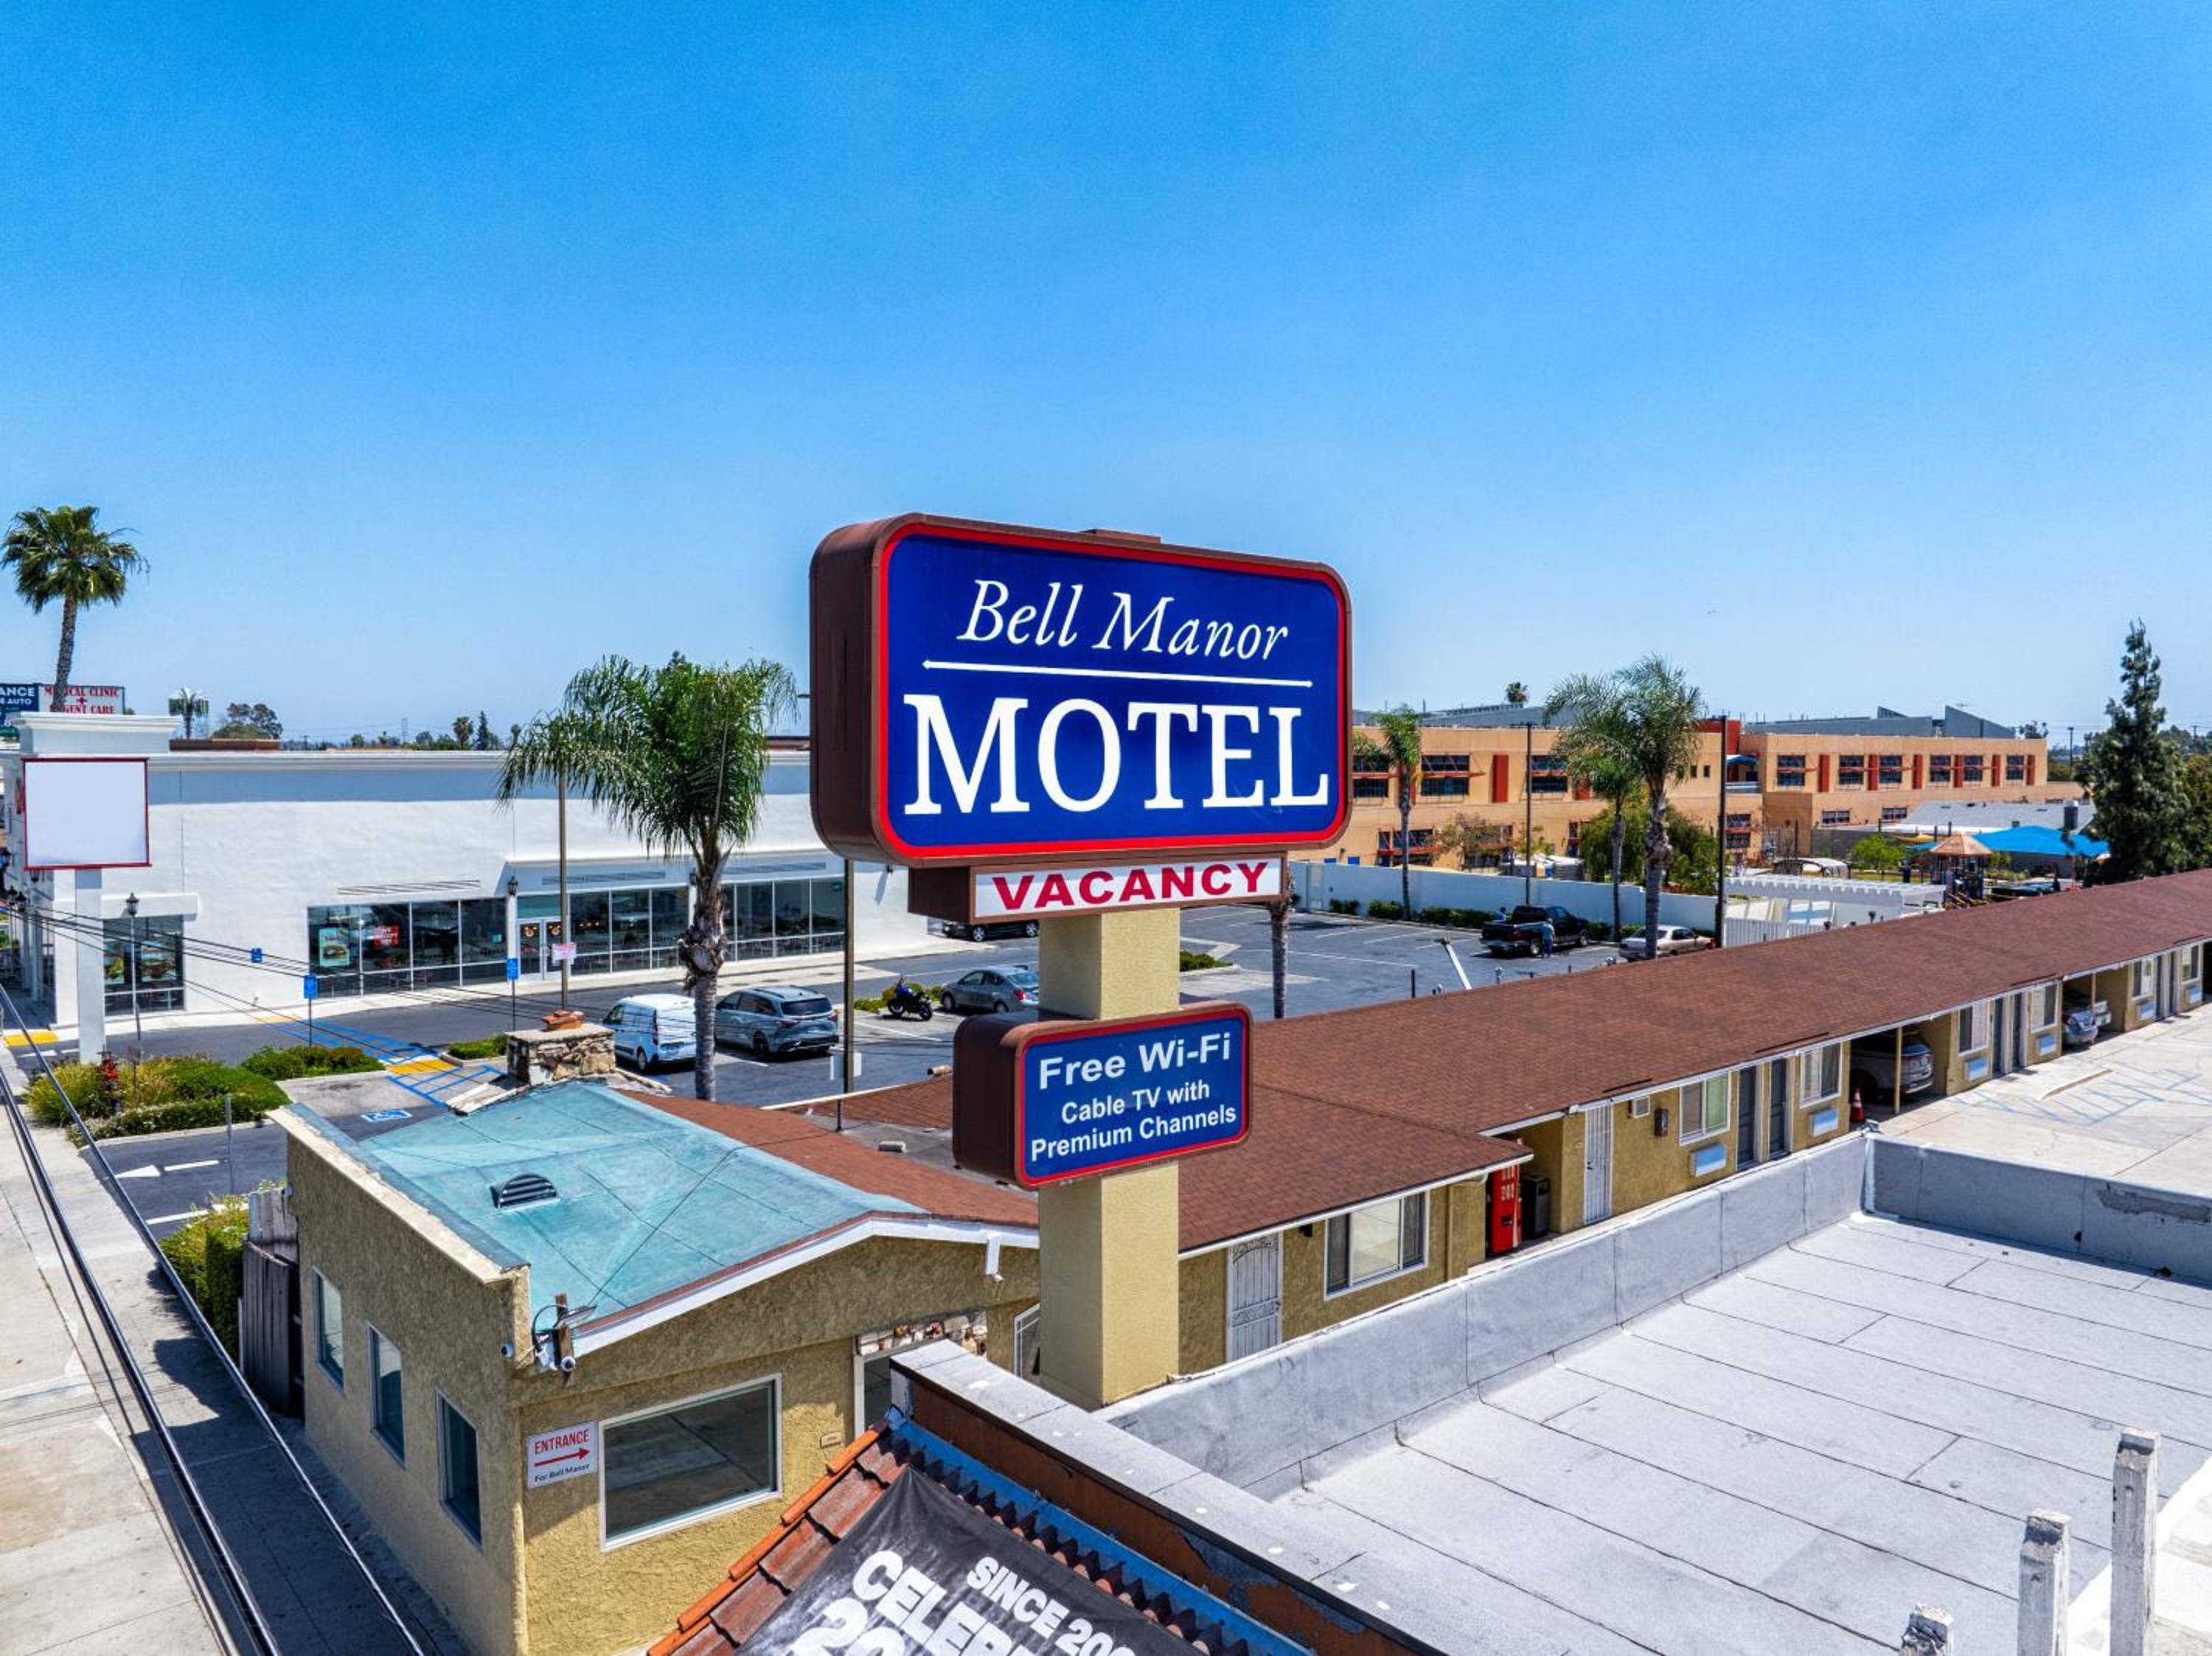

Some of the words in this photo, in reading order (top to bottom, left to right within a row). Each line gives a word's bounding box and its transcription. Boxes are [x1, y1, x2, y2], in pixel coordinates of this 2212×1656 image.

[956, 579, 1084, 647] Bell
[1092, 591, 1289, 661] Manor
[89, 687, 119, 697] CLINIC
[91, 705, 114, 714] CARE
[903, 693, 1329, 815] MOTEL
[992, 861, 1270, 911] VACANCY
[1039, 1054, 1127, 1090] Free
[1138, 1032, 1231, 1073] Wi-Fi
[1061, 1095, 1125, 1124] Cable
[1132, 1086, 1161, 1111] TV
[1167, 1079, 1211, 1105] with
[1032, 1125, 1133, 1162] Premium
[1139, 1104, 1237, 1139] Channels
[535, 1429, 590, 1454] ENTRANCE
[535, 1473, 548, 1483] For
[967, 1556, 1070, 1640] SINCE
[1055, 1618, 1136, 1656] 20
